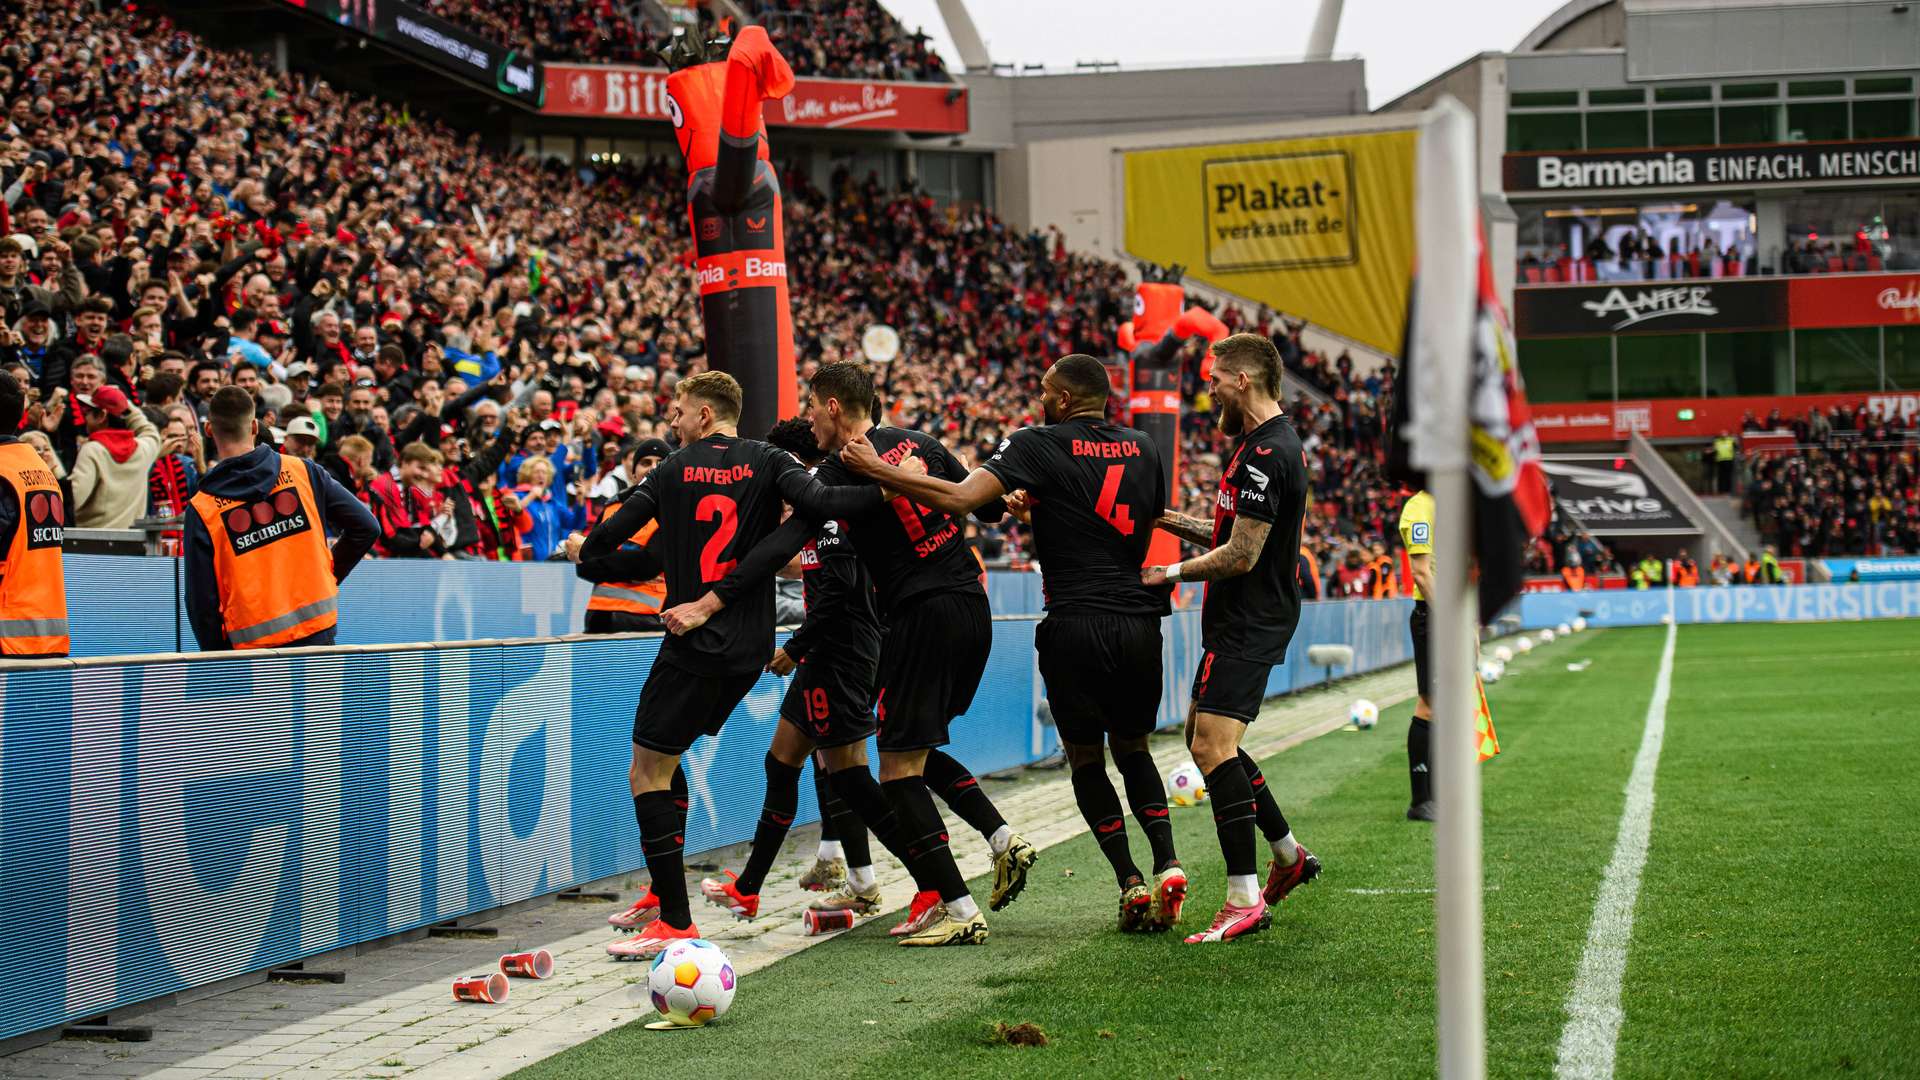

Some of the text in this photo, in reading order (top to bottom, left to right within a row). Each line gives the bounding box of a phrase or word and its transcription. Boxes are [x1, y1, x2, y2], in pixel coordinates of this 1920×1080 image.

[1537, 152, 1695, 188] Barmenia
[1706, 156, 1811, 182] EINFACH.
[1215, 180, 1341, 214] Plakat-
[1216, 216, 1344, 240] verkauft.de
[1095, 464, 1135, 537] 4
[236, 515, 304, 549] SECURITAS
[695, 494, 739, 584] 2
[914, 521, 959, 558] SCHICK
[803, 687, 830, 721] 19
